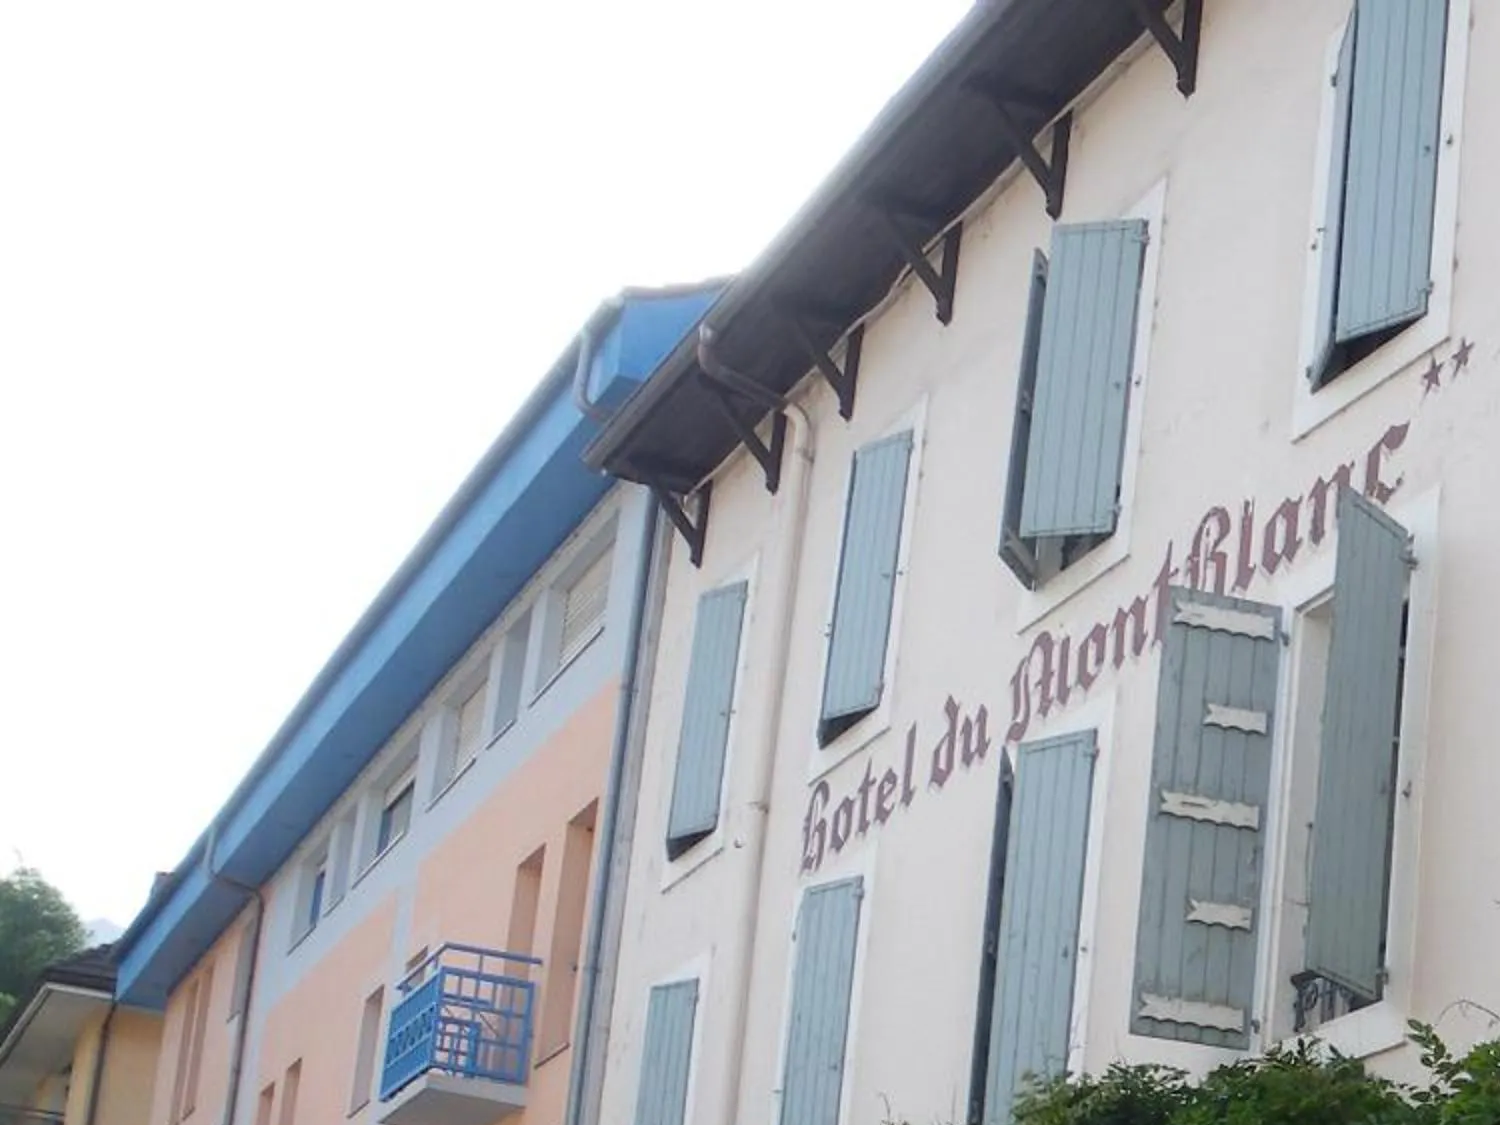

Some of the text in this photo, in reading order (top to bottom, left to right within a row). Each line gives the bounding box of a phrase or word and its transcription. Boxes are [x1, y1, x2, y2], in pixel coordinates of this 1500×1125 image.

[800, 421, 1410, 877] Hotel du Mont Blanc
